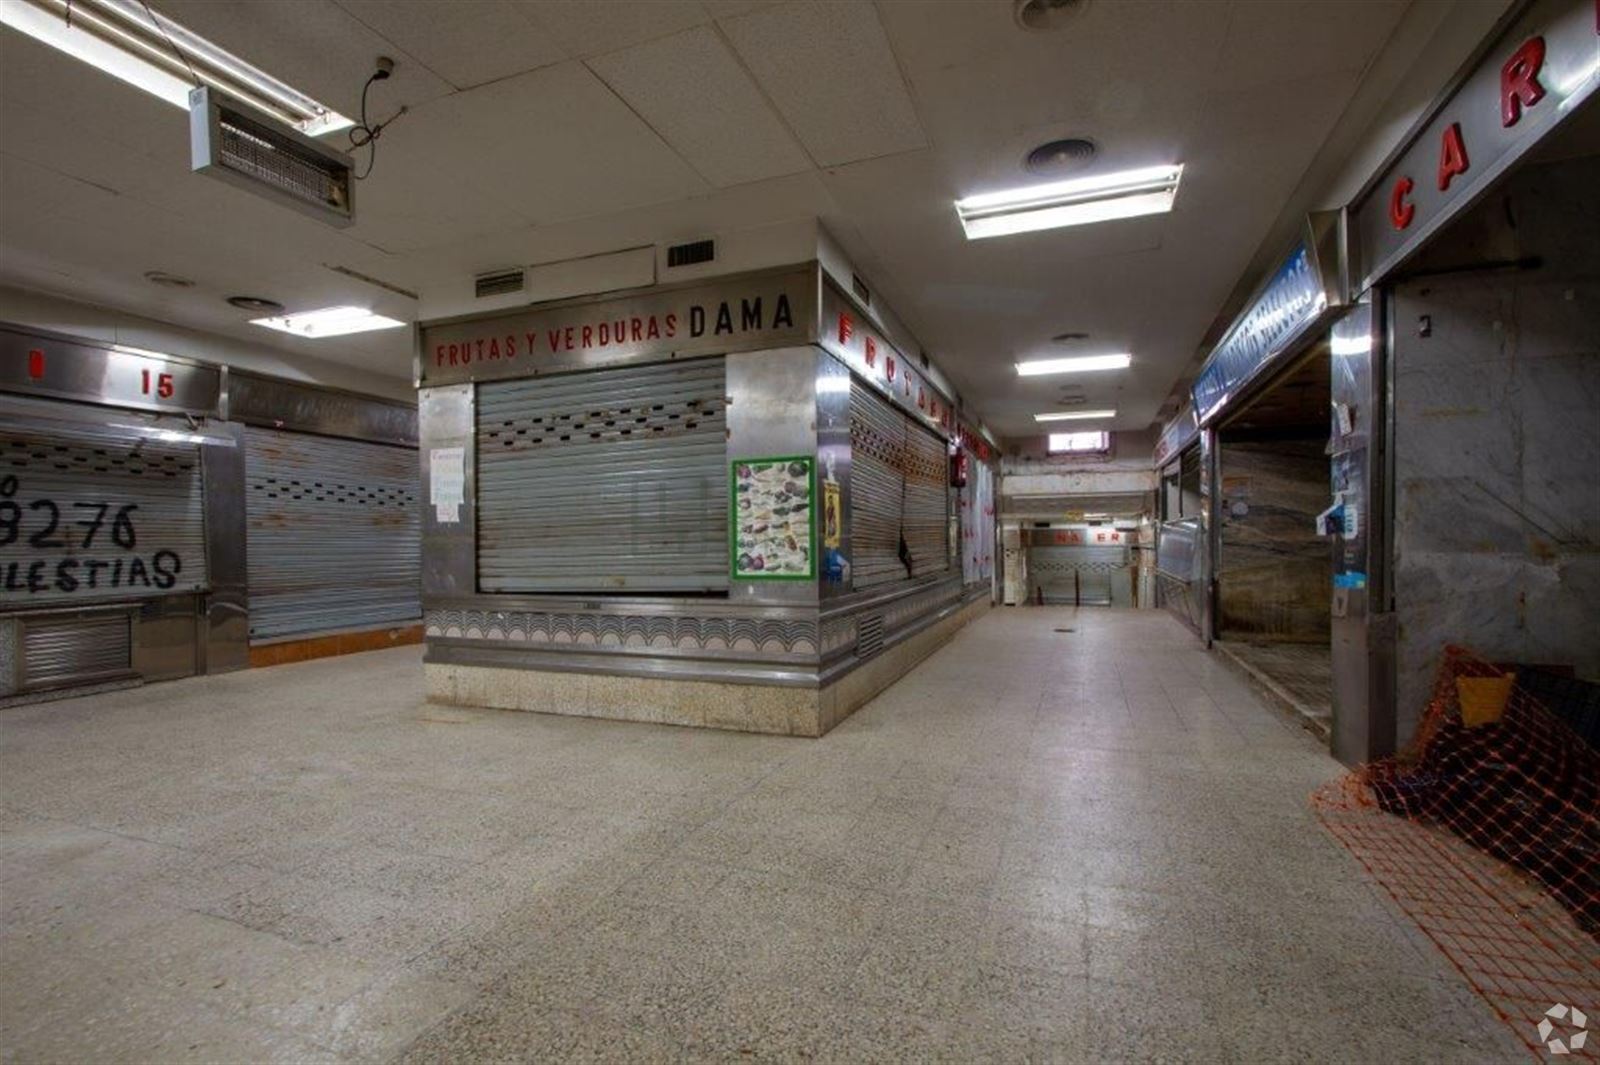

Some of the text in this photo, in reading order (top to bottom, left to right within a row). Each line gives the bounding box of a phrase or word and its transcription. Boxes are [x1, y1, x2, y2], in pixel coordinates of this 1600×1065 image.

[1389, 0, 1600, 231] CAR
[436, 294, 794, 366] FRUTAS Y VERDURAS DAMA
[141, 369, 175, 398] 15
[0, 550, 181, 593] LESTIAS
